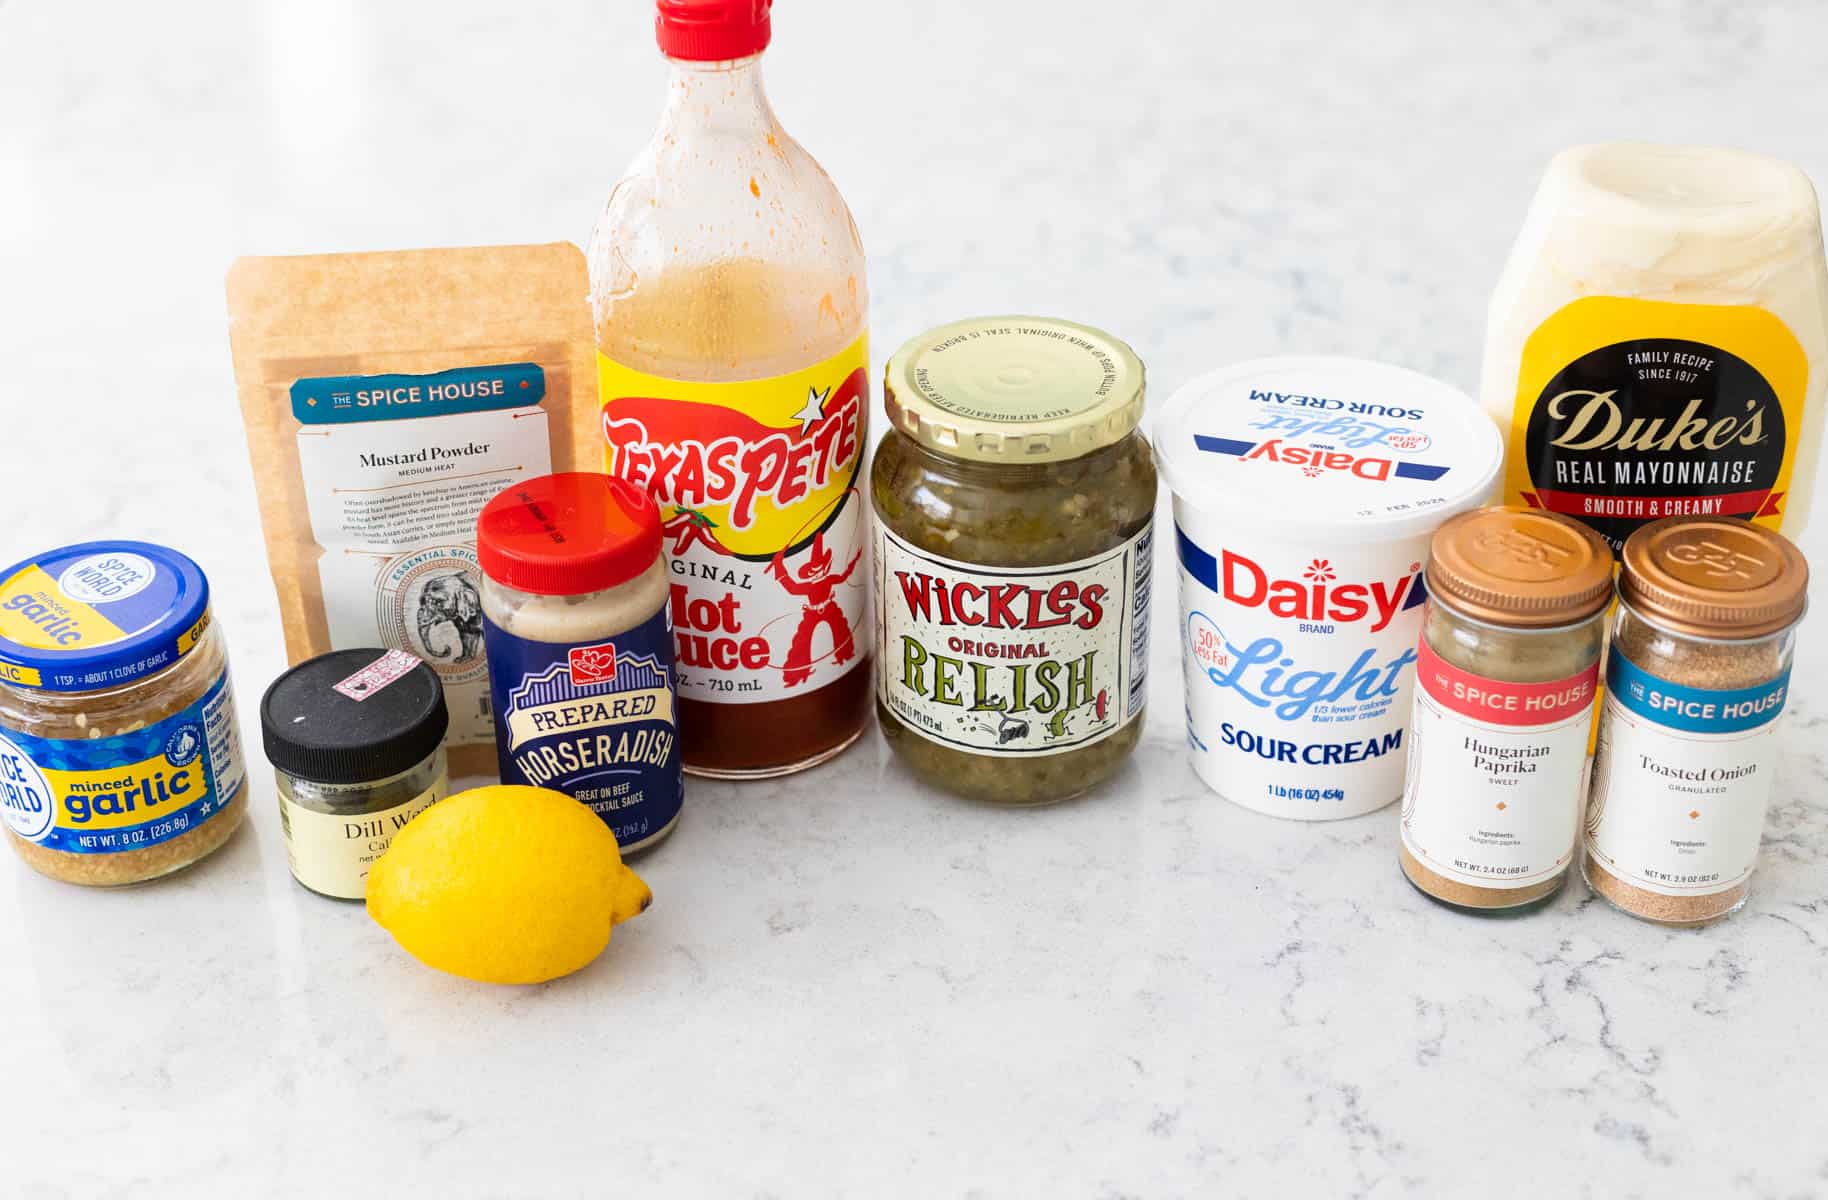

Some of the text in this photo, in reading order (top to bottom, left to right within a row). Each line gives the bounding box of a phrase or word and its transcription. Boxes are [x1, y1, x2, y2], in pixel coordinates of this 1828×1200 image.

[932, 335, 967, 352] BROKEN
[986, 327, 1011, 335] SEAL
[1017, 327, 1067, 340] ORIGINAL
[1069, 335, 1093, 351] WHEN
[1627, 352, 1715, 371] FAMILY RECIPE
[1638, 369, 1699, 383] SINCE 1917
[333, 380, 505, 408] THE SPICE HOUSE
[929, 393, 956, 409] AFTER
[1249, 389, 1345, 411] CREAM
[956, 406, 1038, 421] REFRIGERATED
[1043, 408, 1070, 418] KEEP
[1348, 402, 1424, 421] SOUR
[1546, 389, 1768, 451] Duke's
[1248, 416, 1410, 448] Light
[360, 442, 491, 468] Mustard Powder
[602, 393, 861, 530] TEXAS PETE
[1249, 440, 1393, 482] Daisy
[398, 462, 456, 477] MEDIUM HEAT
[1556, 459, 1758, 486] REAL MAYONNAISE
[1583, 497, 1724, 516] SMOOTH & CREAMY
[97, 558, 143, 586] SPICE
[392, 548, 477, 581] ESSENTIAL SPIC
[671, 560, 753, 590] GINAL
[73, 566, 122, 597] WORLD
[1221, 547, 1412, 634] Daisy
[3, 594, 82, 645] garlic
[191, 615, 210, 642] GAR
[1299, 623, 1335, 635] BRAND
[676, 631, 771, 671] uce
[948, 636, 1050, 659] ORIGINAL
[0, 662, 21, 677] LIC
[58, 674, 78, 685] TSP.
[84, 671, 109, 684] ABOUT
[114, 664, 137, 678] CLOVE
[138, 661, 146, 671] OF
[146, 650, 169, 667] GARLIC
[900, 635, 1098, 714] RELISH
[1207, 637, 1418, 722] Light
[708, 679, 734, 692] 710
[738, 679, 762, 692] mL
[1452, 681, 1520, 711] SPICE
[1524, 680, 1590, 711] HOUSE
[530, 695, 656, 732] PREPARED
[1648, 690, 1716, 719] SPICE
[1721, 687, 1785, 719] HOUSE
[1221, 723, 1404, 766] SOUR CREAM
[1464, 736, 1552, 761] Hungarian
[0, 753, 27, 782] ICE
[515, 729, 674, 787] HORSERADISH
[1473, 754, 1538, 776] Paprika
[1639, 753, 1758, 782] Toasted Onion
[70, 775, 135, 793] minced
[575, 782, 630, 801] GREAT ON BEEF
[1267, 783, 1272, 796] 1
[1489, 777, 1520, 786] SWEET
[1667, 784, 1727, 794] GRANULATED
[0, 780, 42, 813] ORLD
[64, 770, 191, 824] garlic
[590, 790, 644, 812] OCKTAIL SAUCE
[79, 812, 190, 848] NET WT. 8 OZ. (226.8g)
[345, 819, 385, 840] Dill
[359, 855, 374, 864] net
[1454, 858, 1469, 869] NET
[1496, 866, 1506, 874] OZ
[1644, 868, 1659, 878] NET
